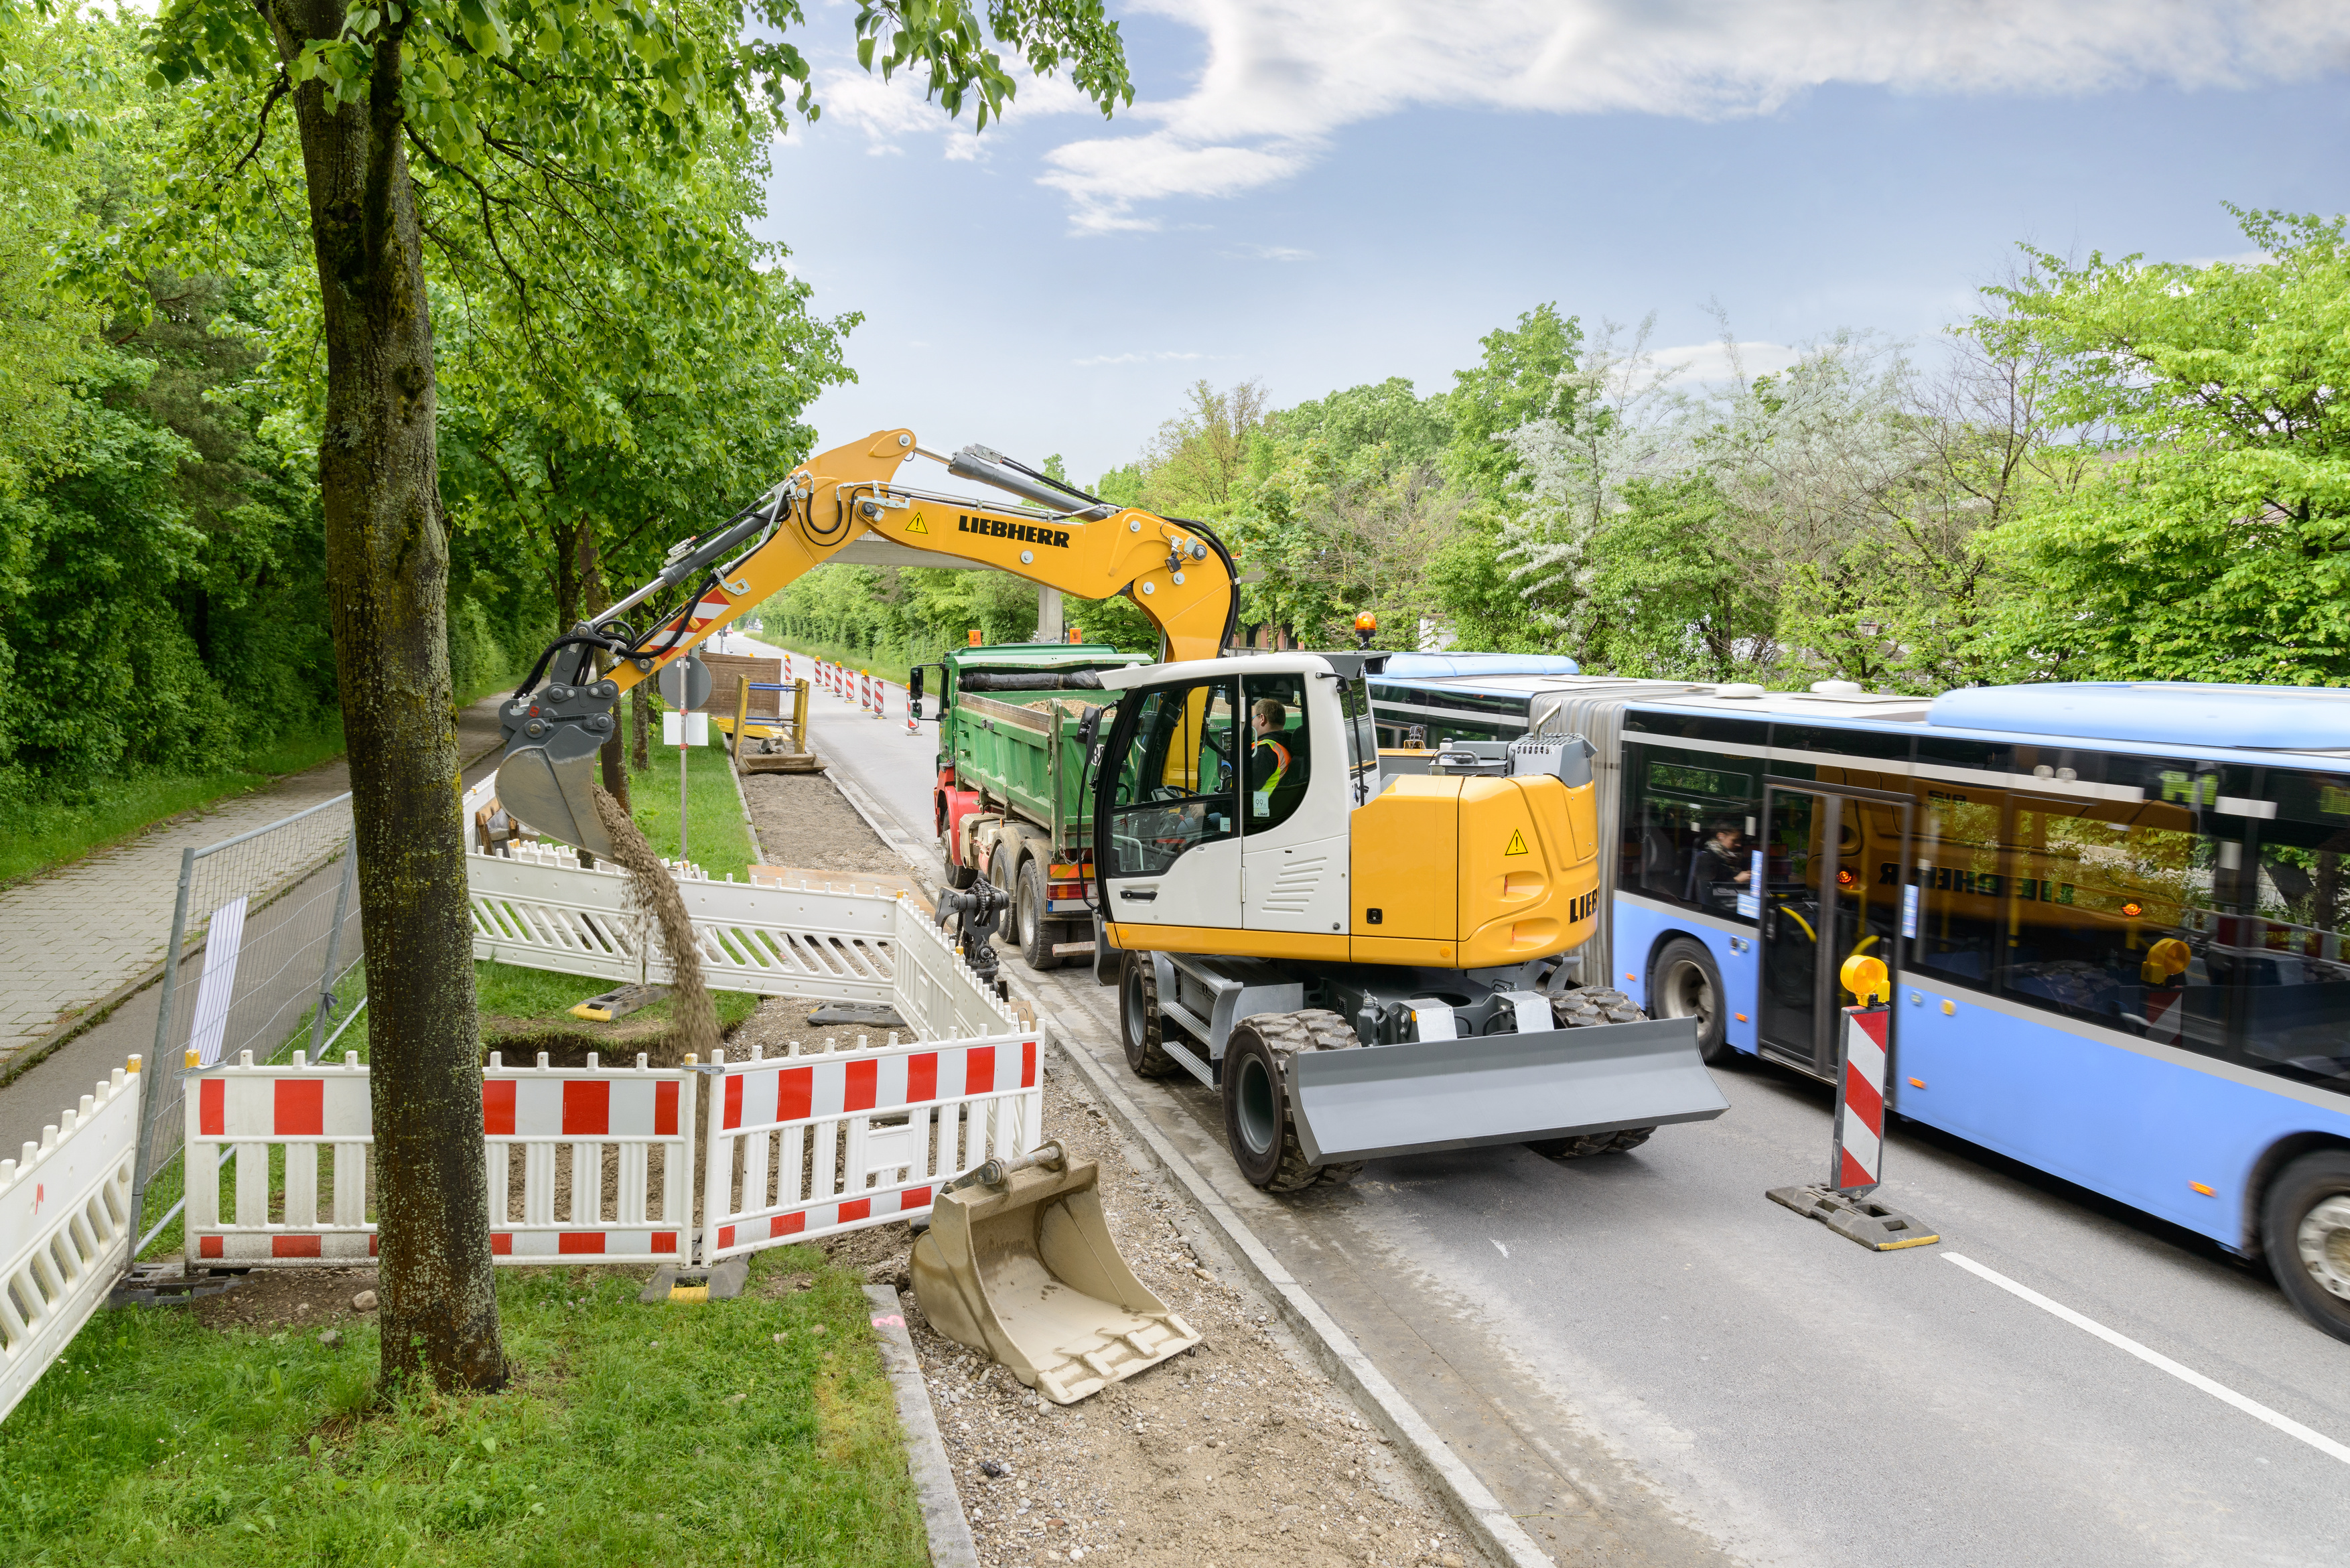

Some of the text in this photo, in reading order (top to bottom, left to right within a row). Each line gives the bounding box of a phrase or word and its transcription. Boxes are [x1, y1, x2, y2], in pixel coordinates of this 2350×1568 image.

[959, 515, 1070, 549] LIEBHERR
[1255, 798, 1263, 807] 99
[1570, 887, 1598, 924] LIEB
